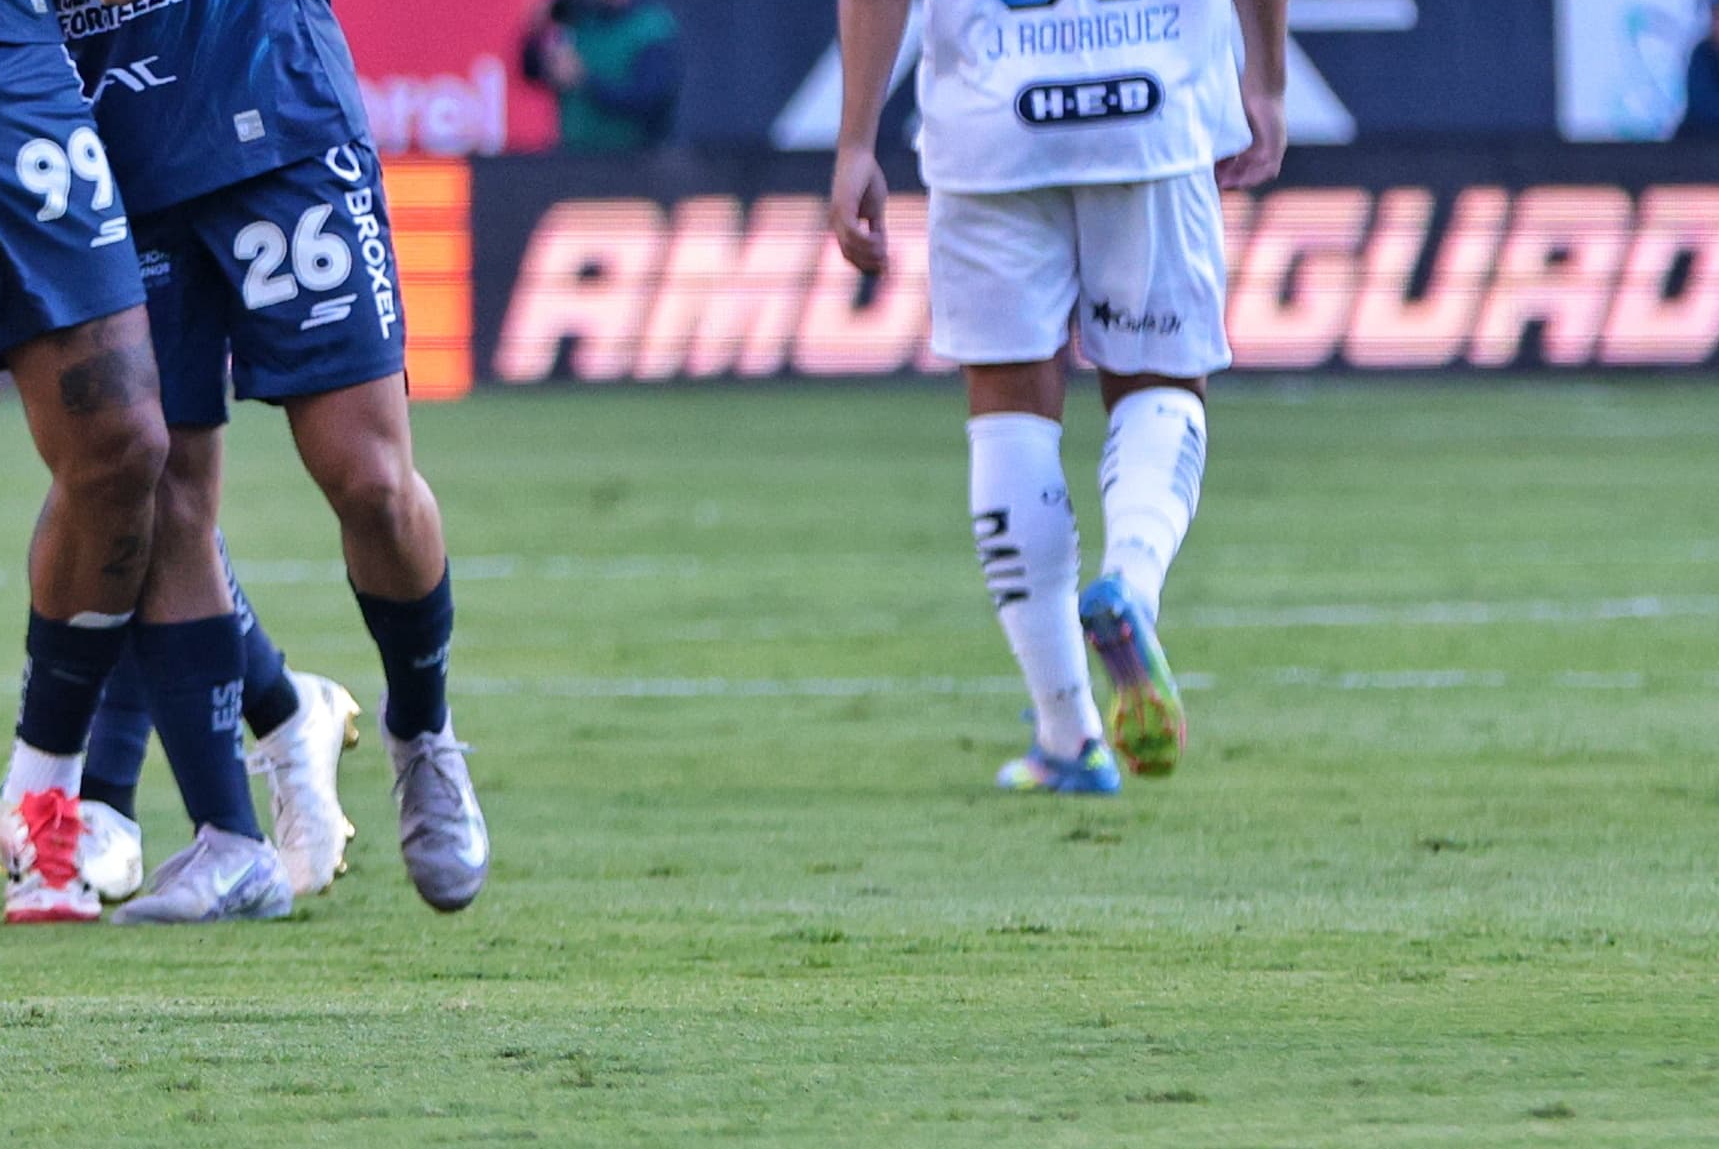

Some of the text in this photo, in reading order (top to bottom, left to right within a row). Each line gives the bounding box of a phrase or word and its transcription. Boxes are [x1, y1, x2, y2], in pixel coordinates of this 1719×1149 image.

[15, 125, 114, 222] 99
[233, 203, 352, 311] 26
[344, 187, 396, 341] BROXEL
